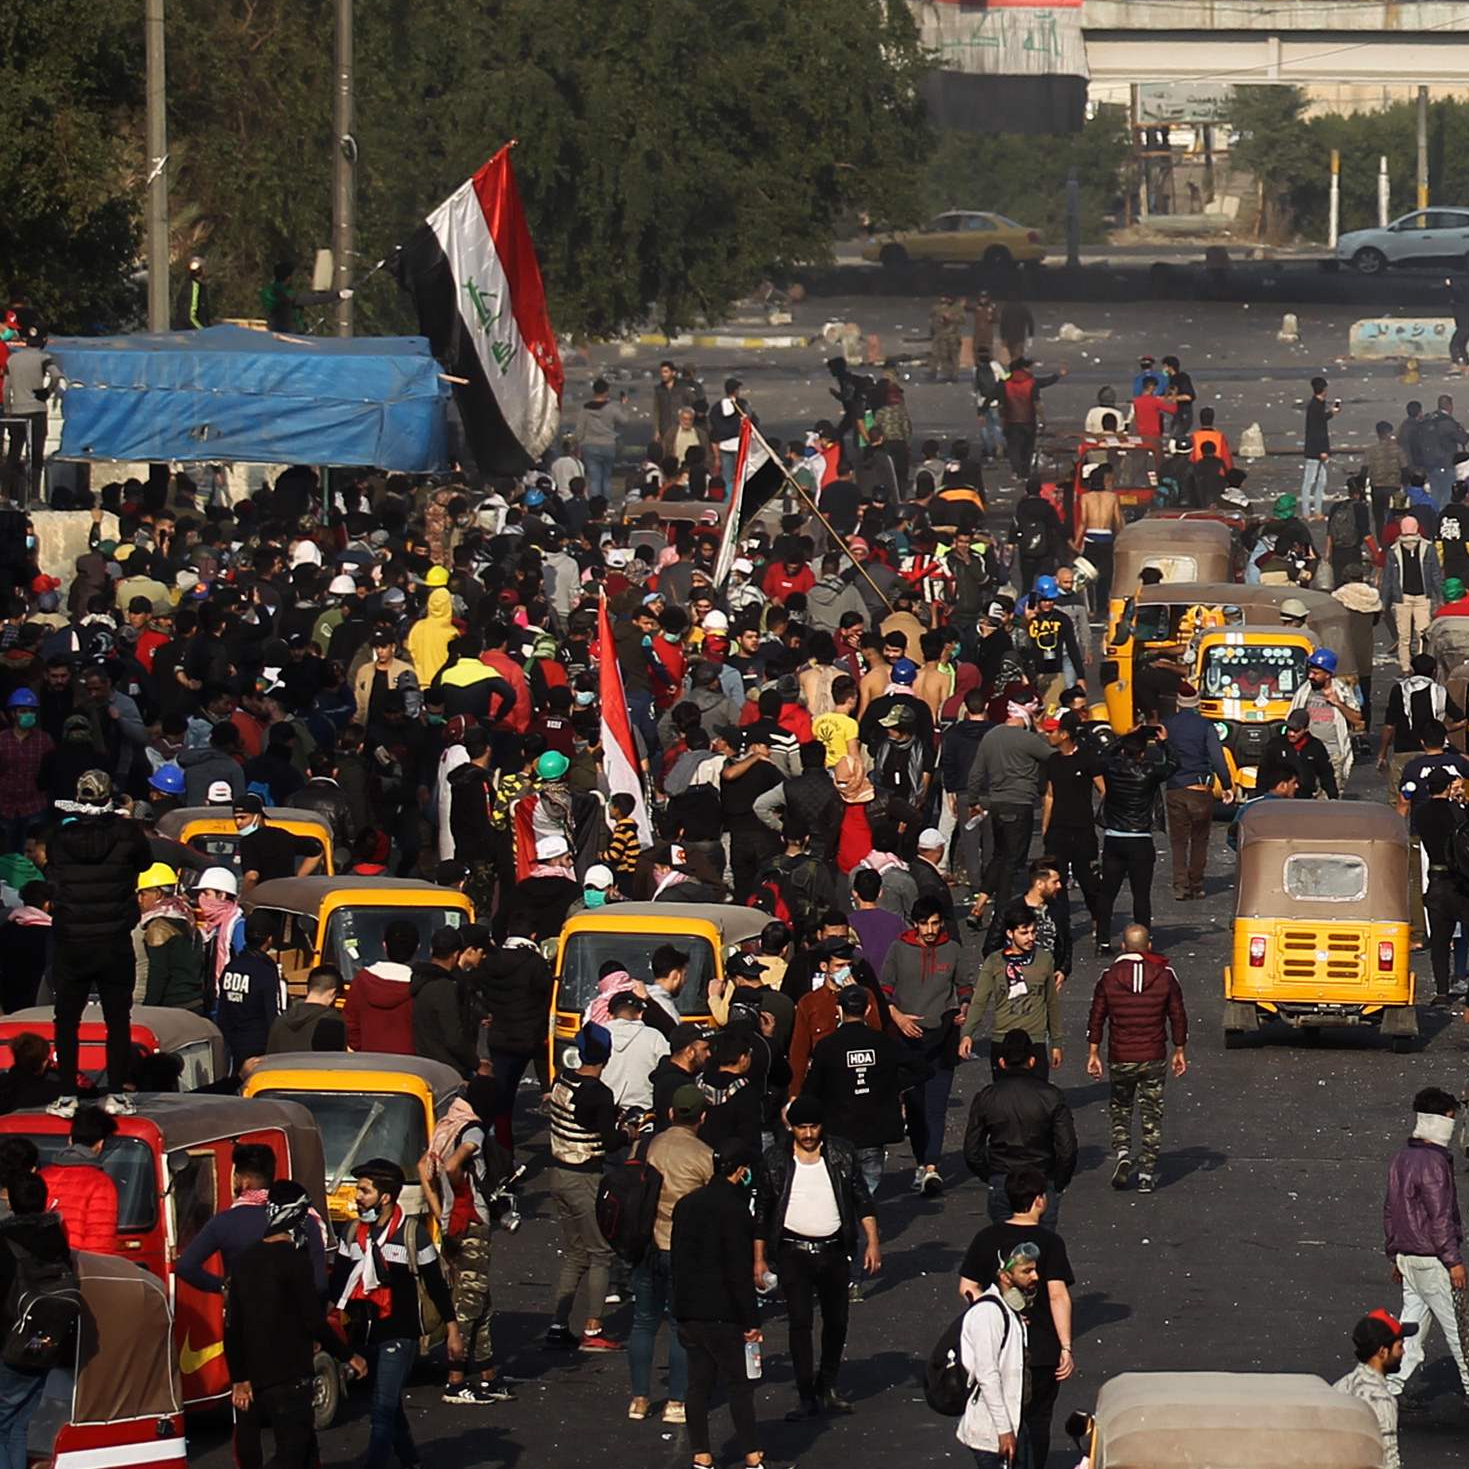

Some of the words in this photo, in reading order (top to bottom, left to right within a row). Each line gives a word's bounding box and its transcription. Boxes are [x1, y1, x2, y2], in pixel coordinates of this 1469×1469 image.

[1029, 620, 1061, 638] CAT
[223, 972, 250, 994] BDA
[850, 1053, 873, 1064] HDA
